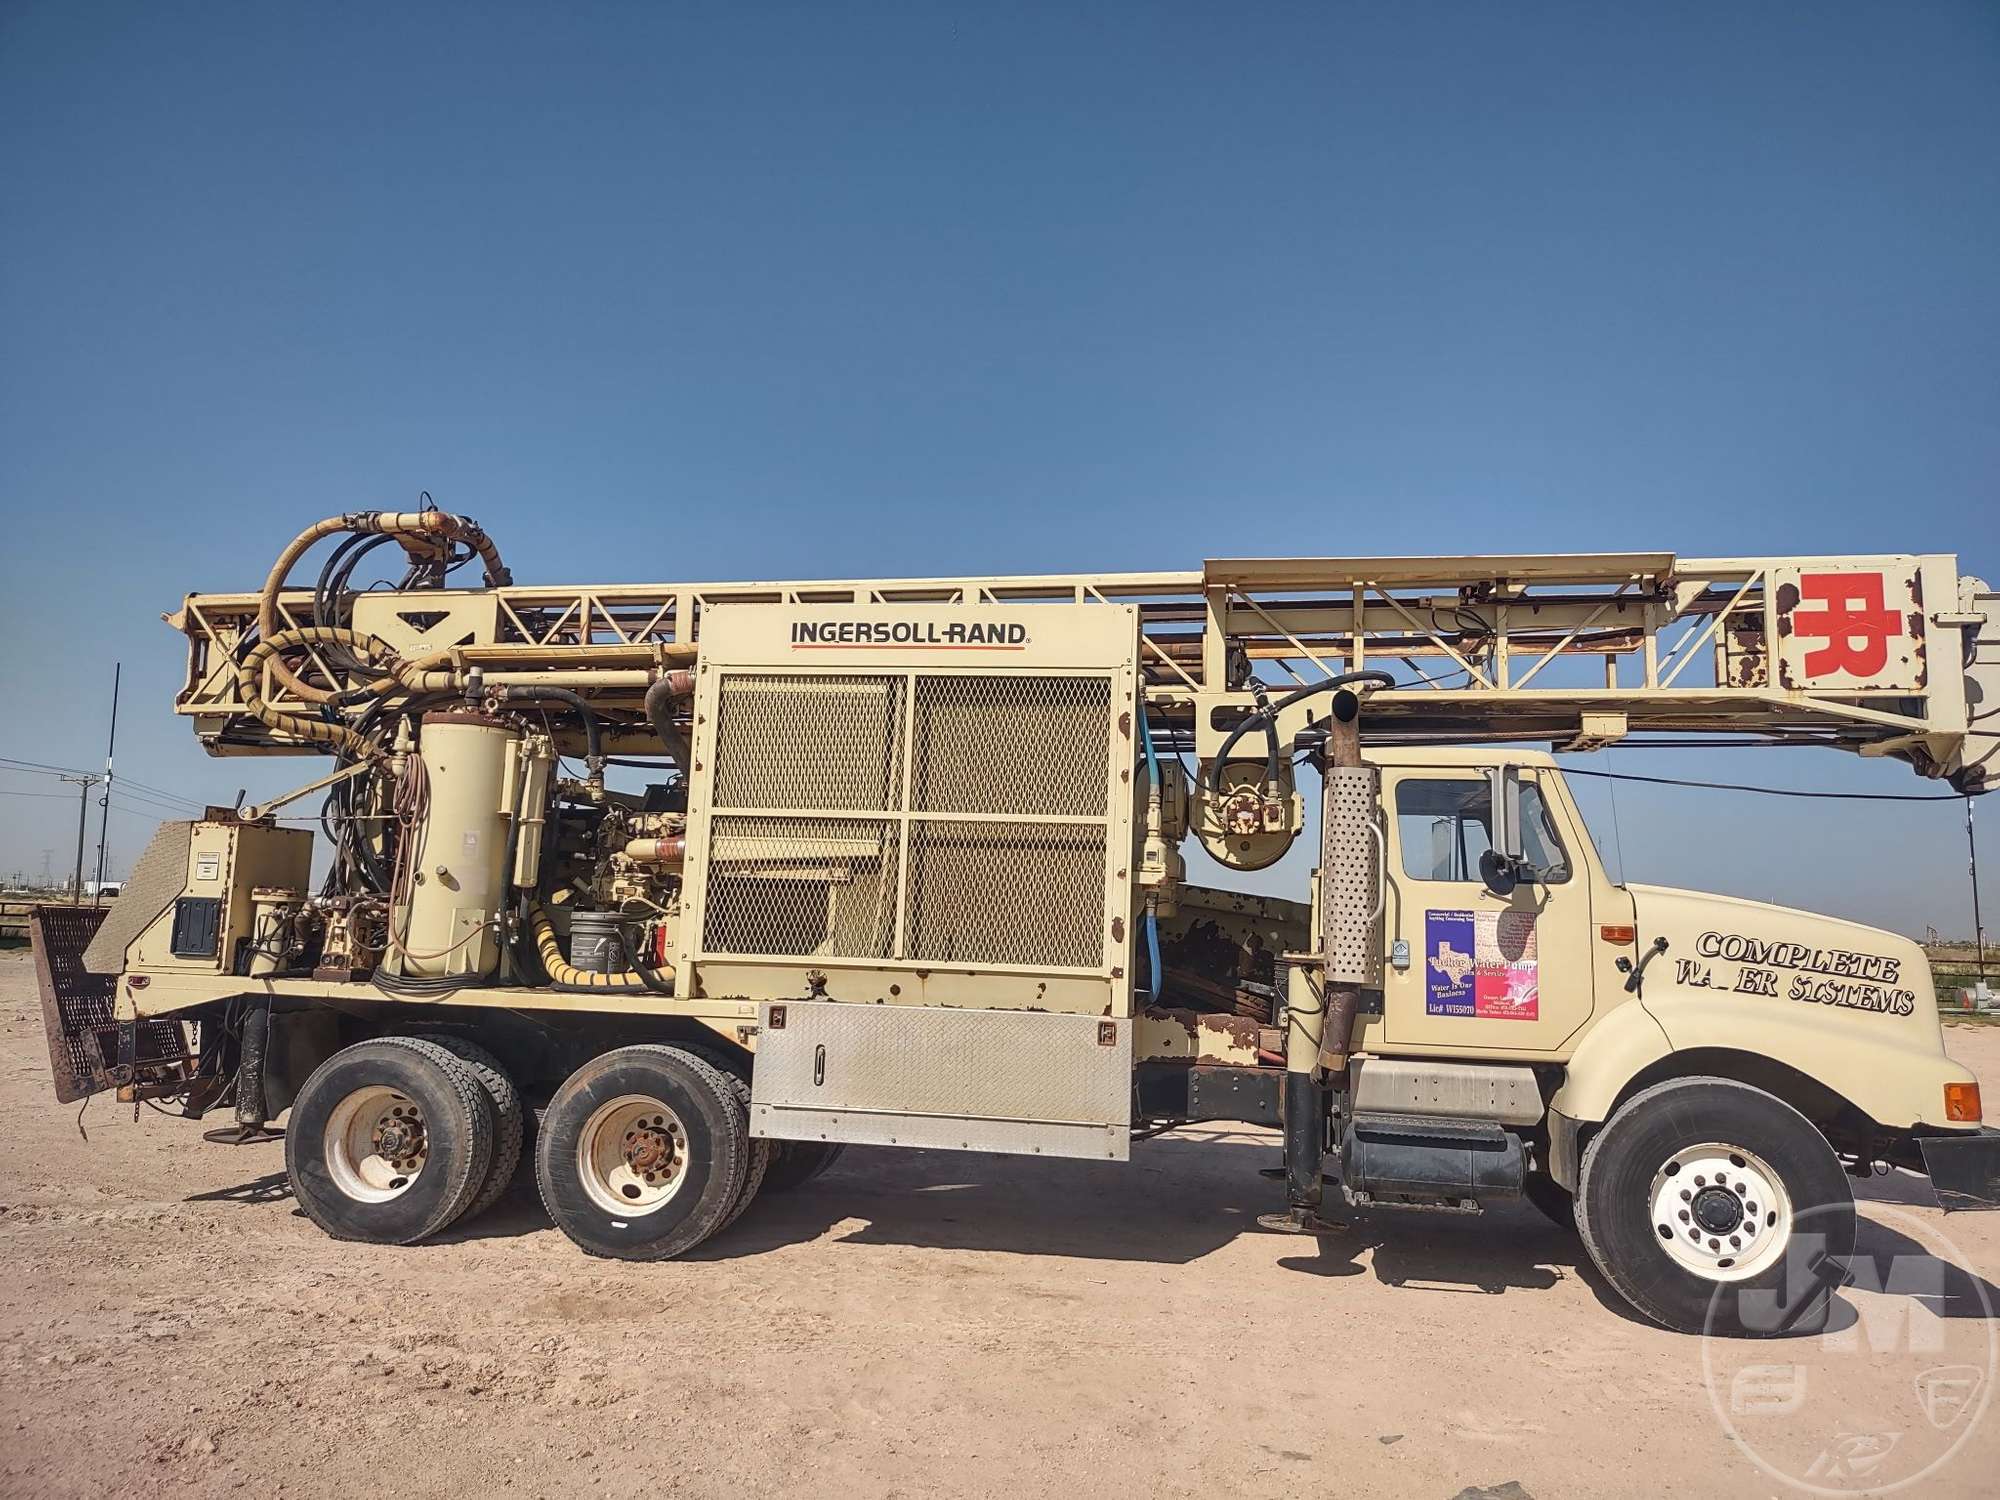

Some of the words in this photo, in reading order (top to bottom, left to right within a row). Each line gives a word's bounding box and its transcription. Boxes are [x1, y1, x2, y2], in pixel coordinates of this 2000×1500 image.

[791, 622, 1026, 644] INGERSOLL-RAND
[1696, 931, 1901, 984] COMPLETE
[1469, 958, 1502, 969] Water
[1504, 960, 1535, 972] Pump
[1431, 984, 1450, 992] Water
[1437, 990, 1466, 999] Business
[1675, 958, 1778, 997] WAER
[1788, 974, 1915, 1017] SYSTEMS
[1429, 1003, 1443, 1013] Lic#
